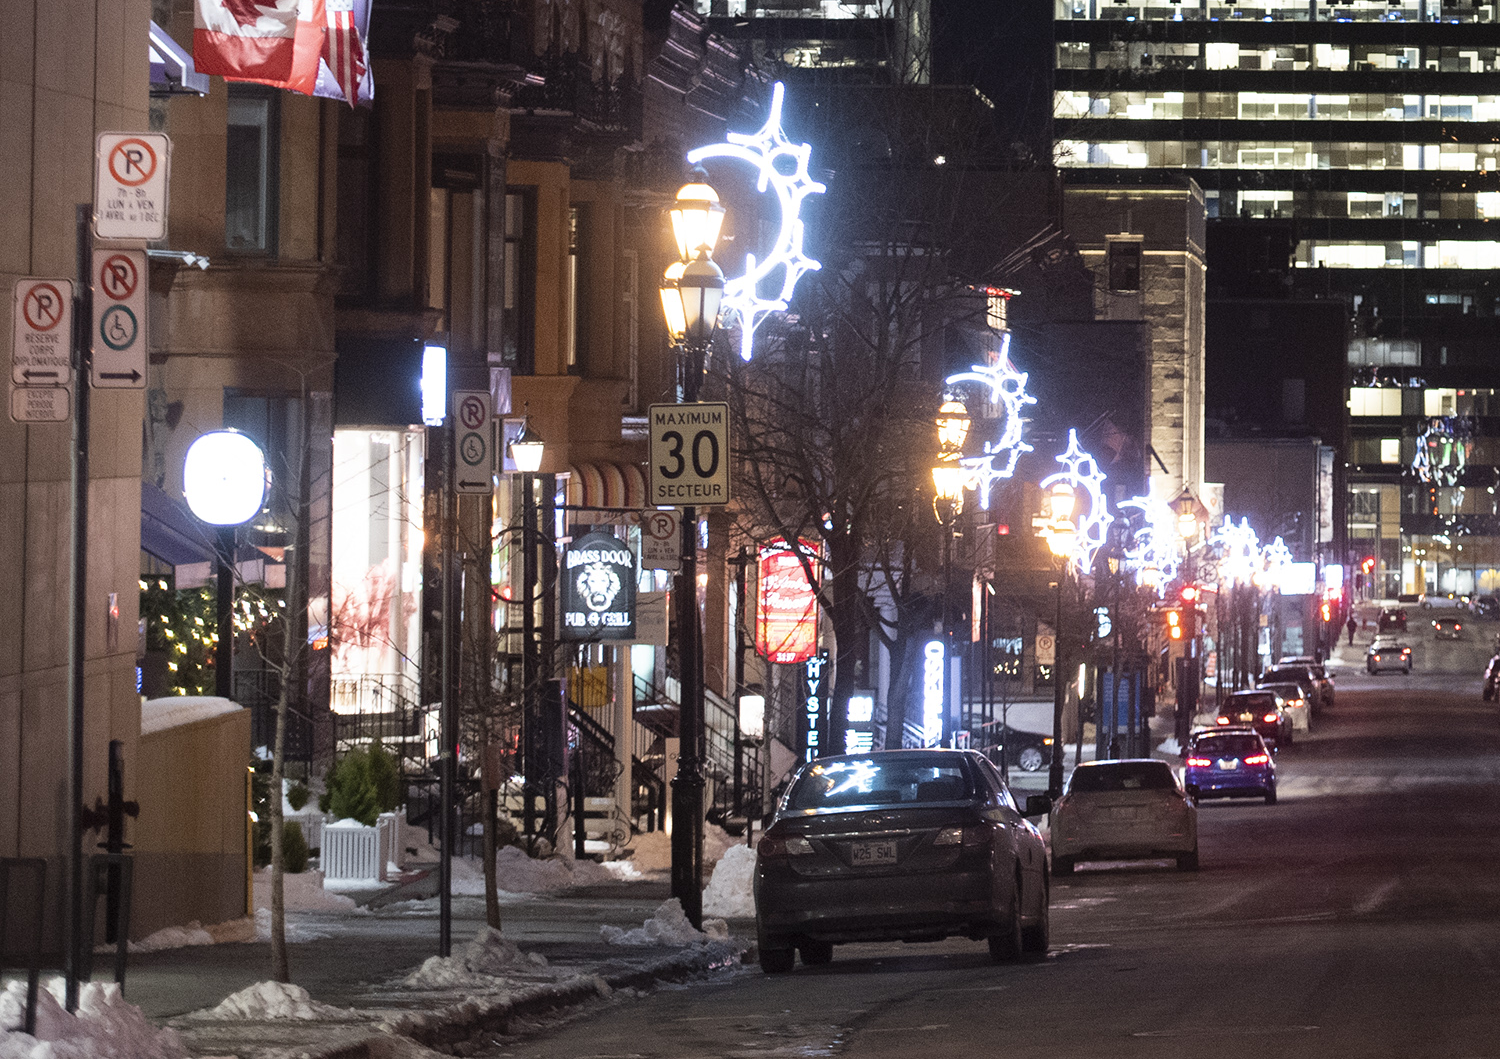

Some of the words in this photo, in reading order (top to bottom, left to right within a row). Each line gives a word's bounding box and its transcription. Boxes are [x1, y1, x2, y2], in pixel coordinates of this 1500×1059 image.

[656, 412, 722, 426] MAXIMUM
[659, 430, 720, 479] 30
[658, 484, 722, 498] SECTEUR
[567, 550, 600, 569] BRASS
[601, 550, 633, 568] DOOR
[565, 612, 586, 627] PUB
[602, 612, 632, 627] GRILL
[806, 662, 820, 763] HYSTE
[853, 846, 872, 860] W25
[876, 845, 896, 859] SWL
